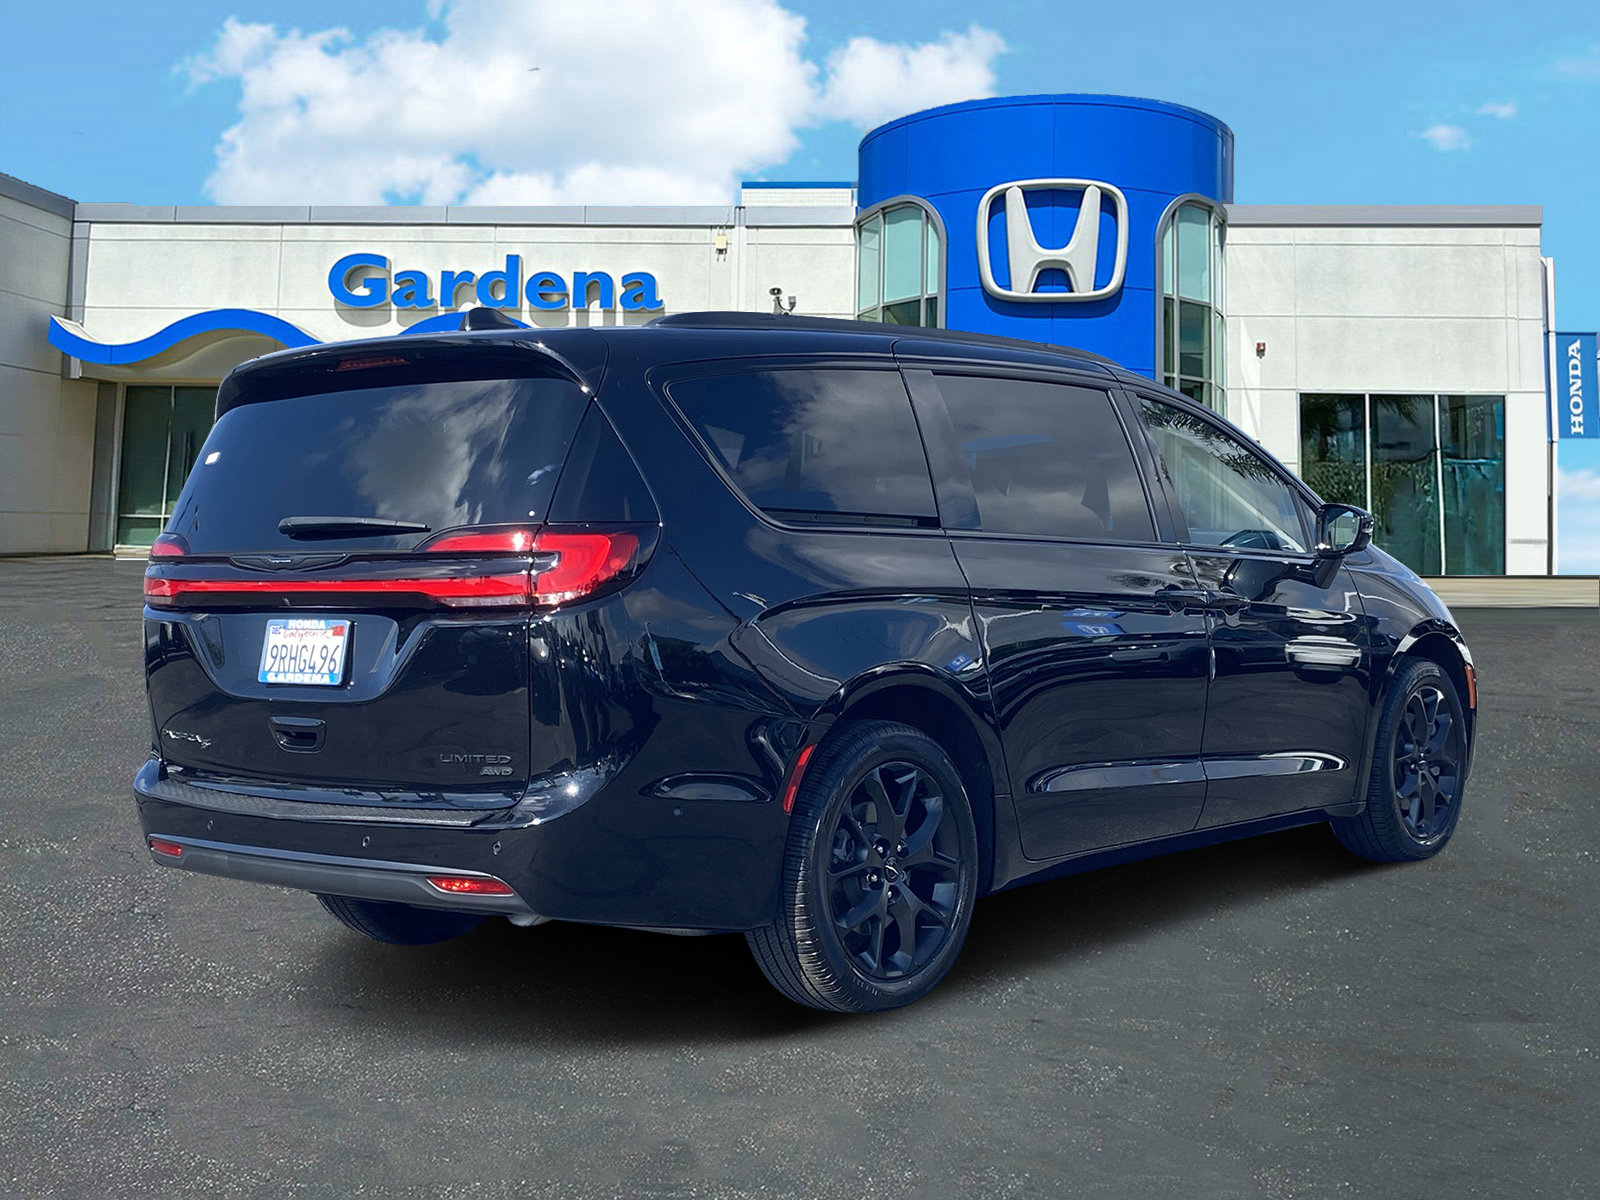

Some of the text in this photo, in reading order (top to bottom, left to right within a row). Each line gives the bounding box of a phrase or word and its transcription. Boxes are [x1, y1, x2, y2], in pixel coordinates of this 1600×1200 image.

[328, 253, 664, 310] Gardena
[1568, 339, 1584, 435] HONDA
[288, 620, 326, 629] HONDA
[268, 644, 340, 674] 9RHG496
[266, 672, 330, 683] GARDENA
[440, 753, 512, 764] LIMITED
[480, 766, 513, 776] AWD
